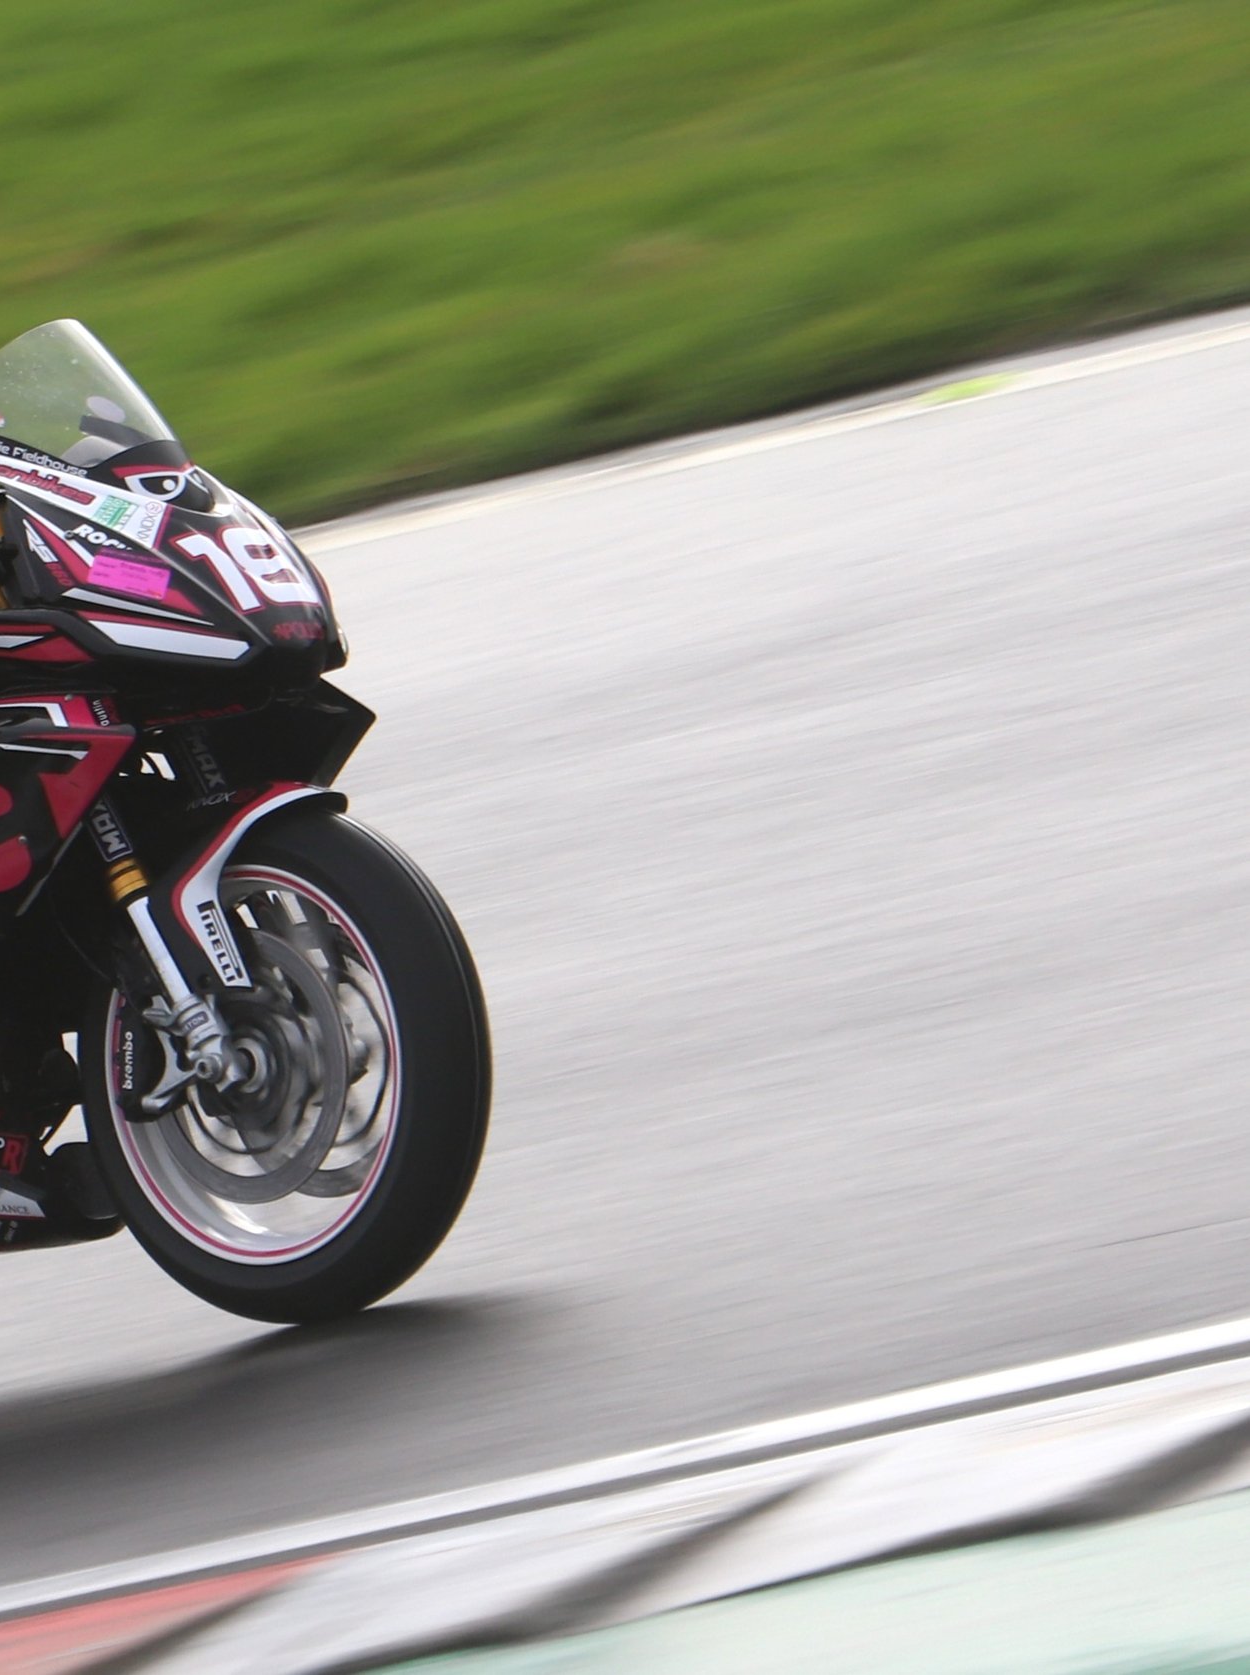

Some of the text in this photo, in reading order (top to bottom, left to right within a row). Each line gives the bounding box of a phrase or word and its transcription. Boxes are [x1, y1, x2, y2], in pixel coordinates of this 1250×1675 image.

[11, 446, 88, 478] Fieldhouse
[171, 524, 320, 613] 18
[197, 900, 244, 985] PIRELLI
[122, 1031, 134, 1090] brembo
